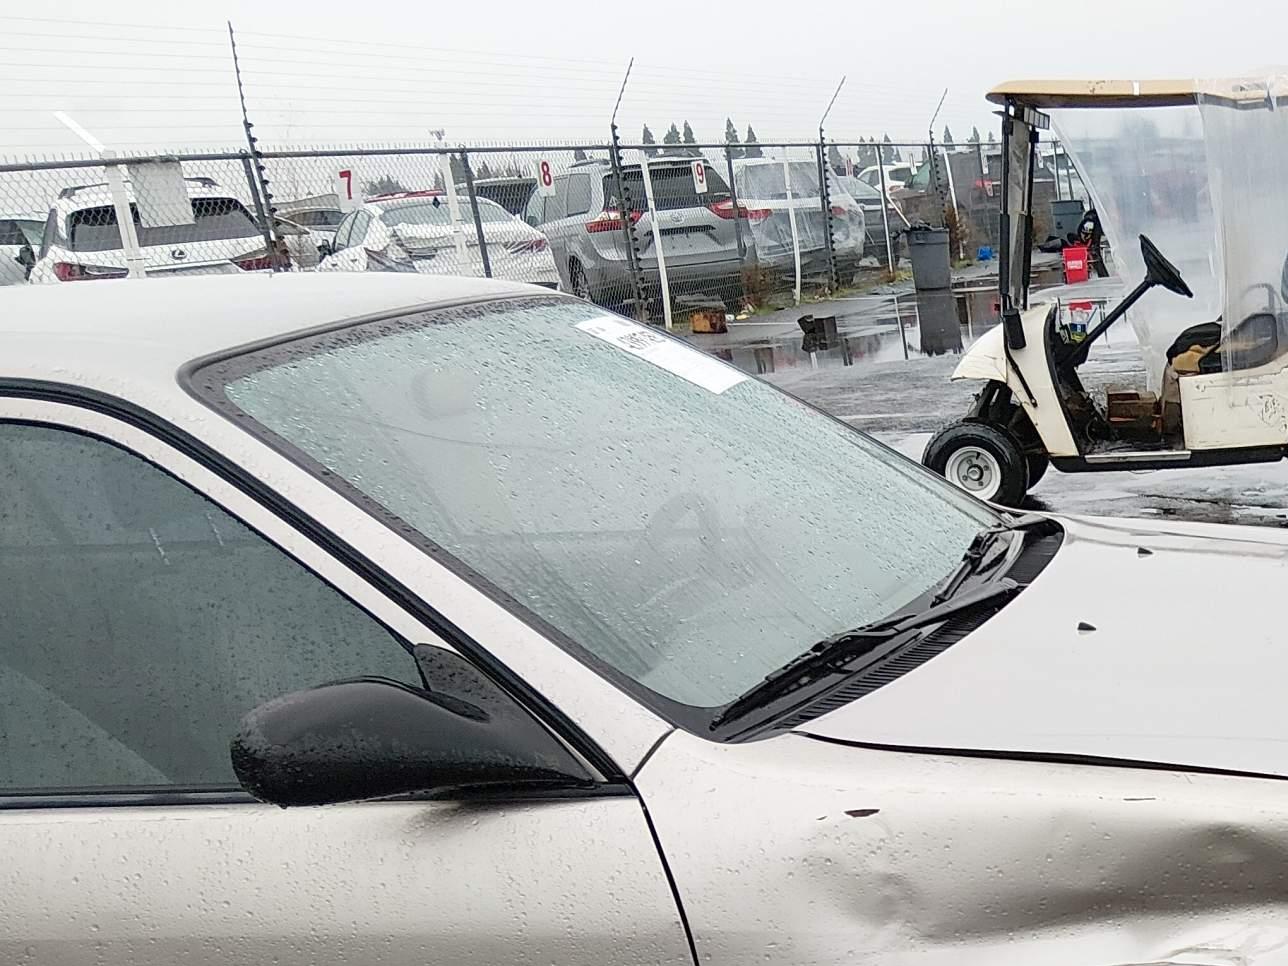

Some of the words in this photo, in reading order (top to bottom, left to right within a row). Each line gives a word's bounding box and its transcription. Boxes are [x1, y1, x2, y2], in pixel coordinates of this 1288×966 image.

[339, 170, 352, 200] 7
[541, 161, 552, 187] 8
[696, 163, 704, 184] 9
